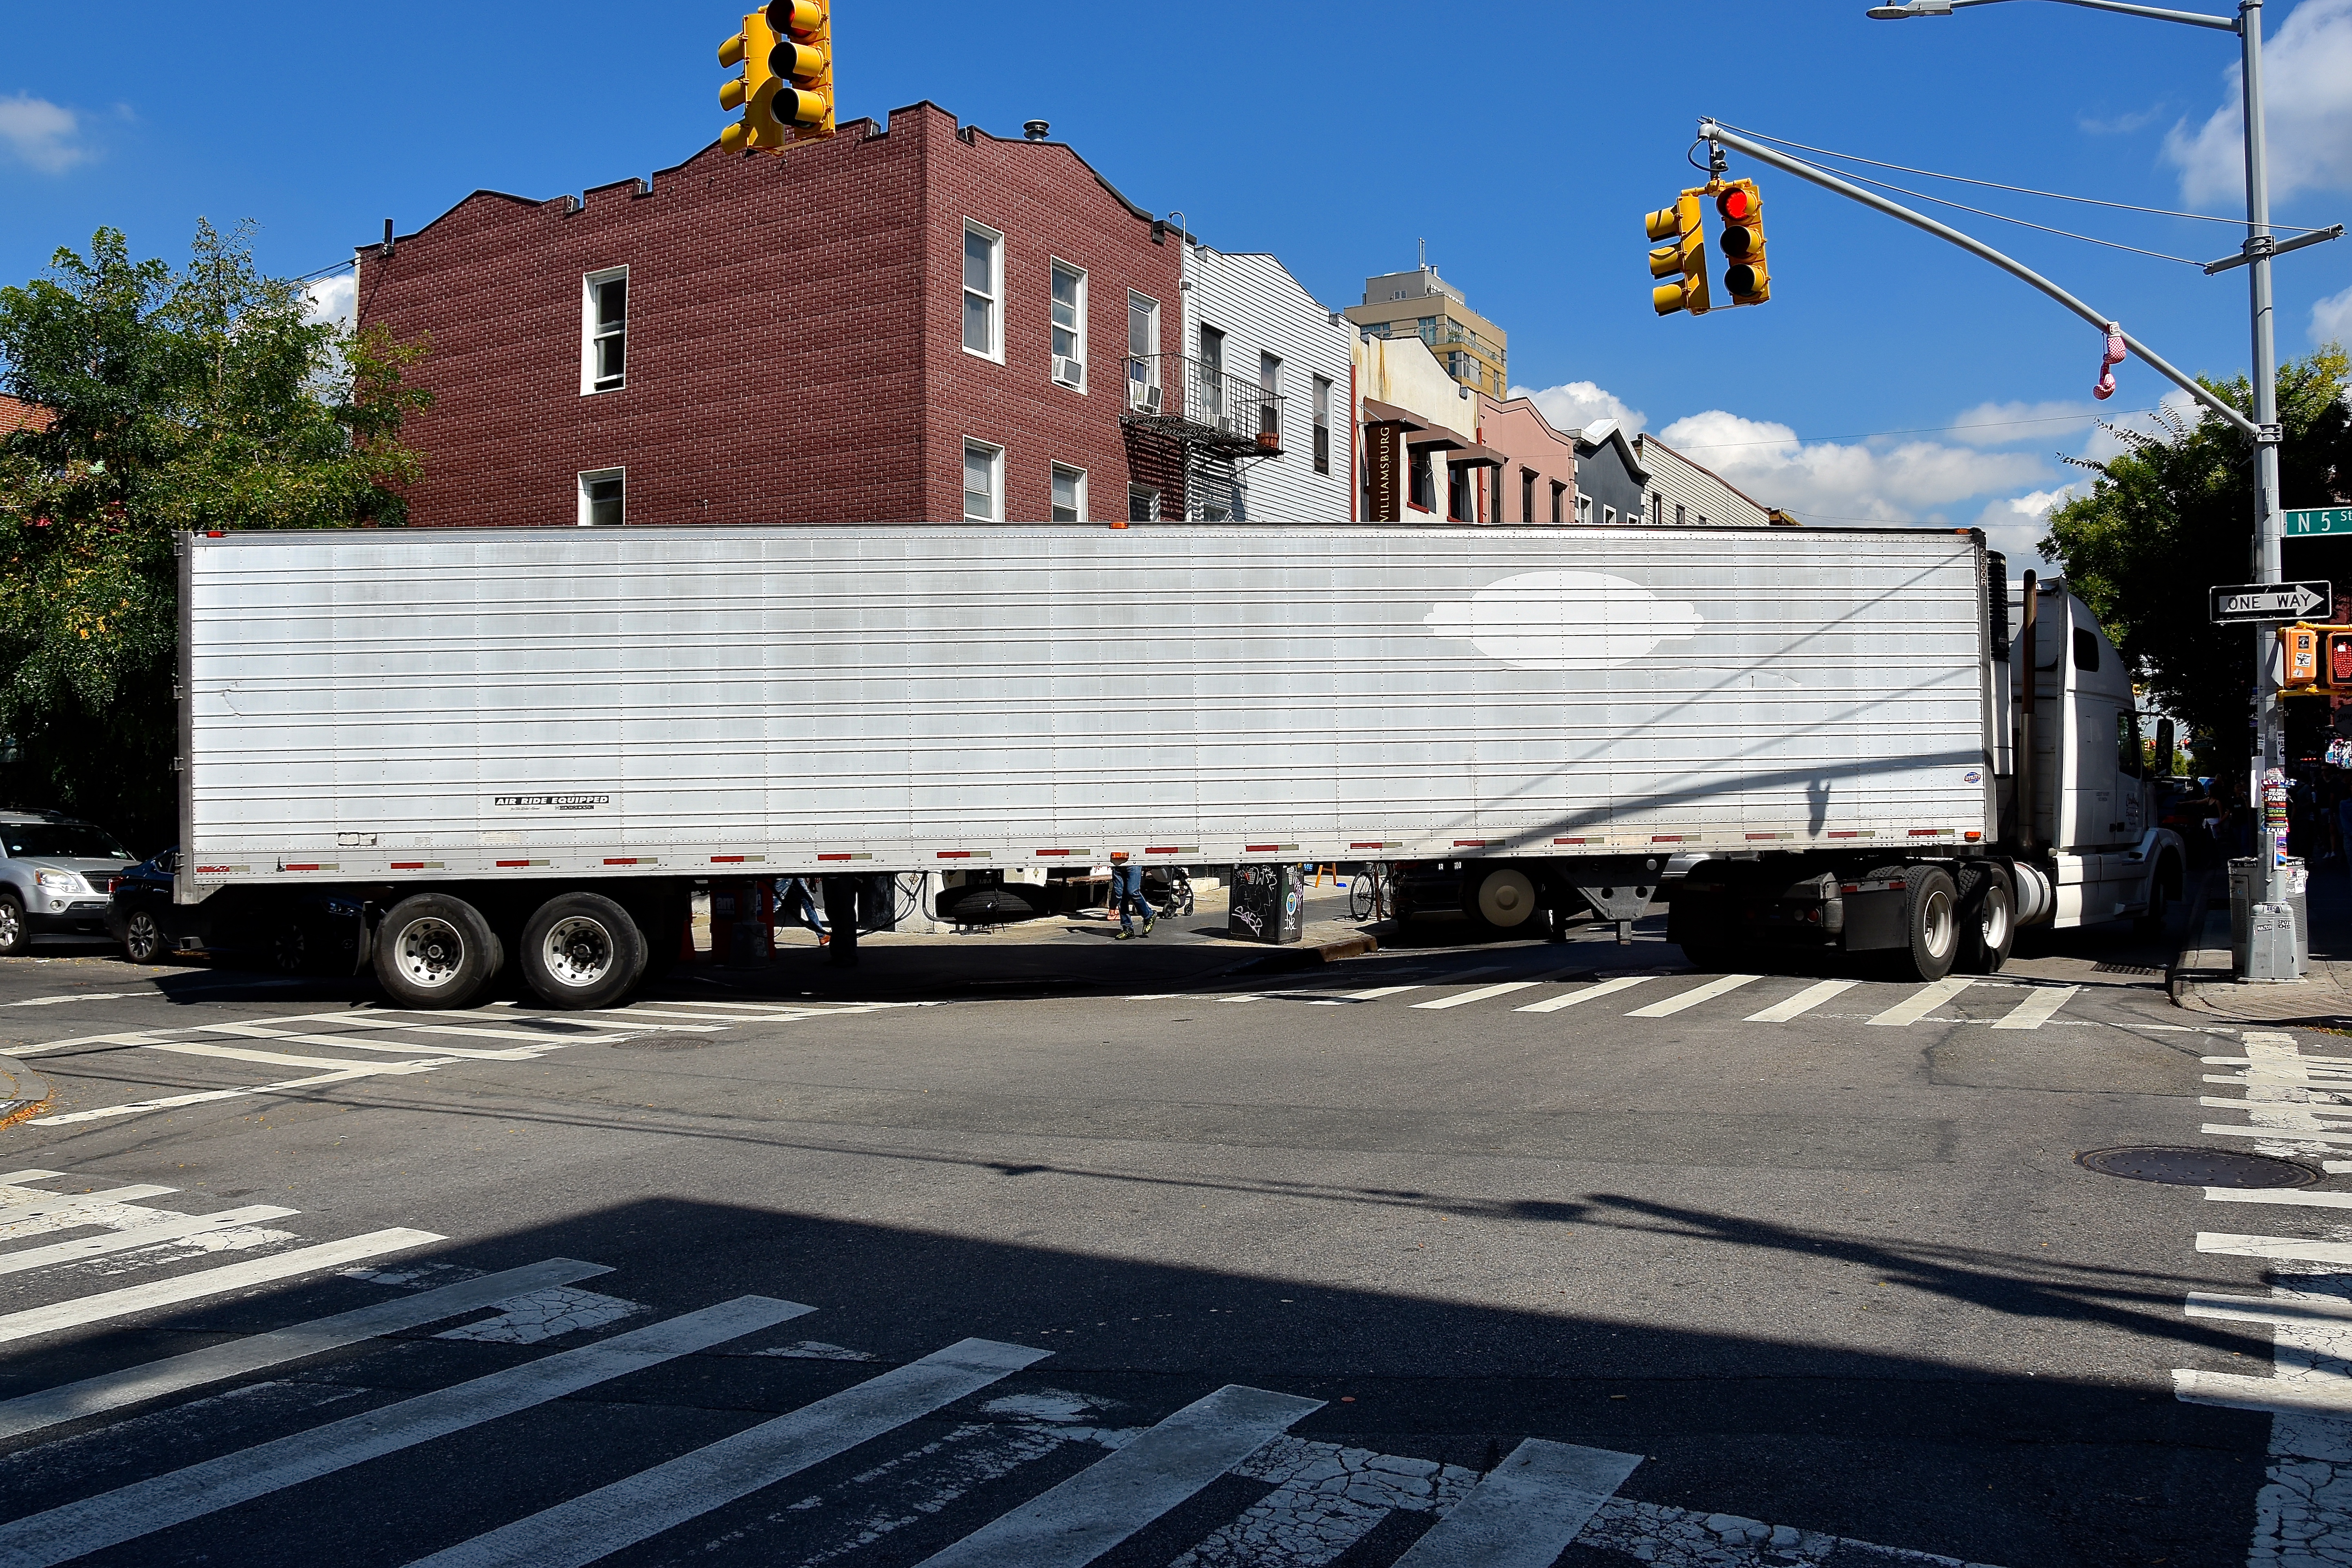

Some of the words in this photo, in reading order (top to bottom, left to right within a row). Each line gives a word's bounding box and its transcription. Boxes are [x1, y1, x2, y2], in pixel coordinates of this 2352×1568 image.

[1380, 427, 1389, 522] WILLIAMSBURG
[2298, 513, 2310, 532] N
[2321, 512, 2330, 531] 5
[2341, 510, 2352, 521] St
[2228, 596, 2261, 610] ONE
[2276, 593, 2312, 608] WAY
[716, 898, 734, 910] am
